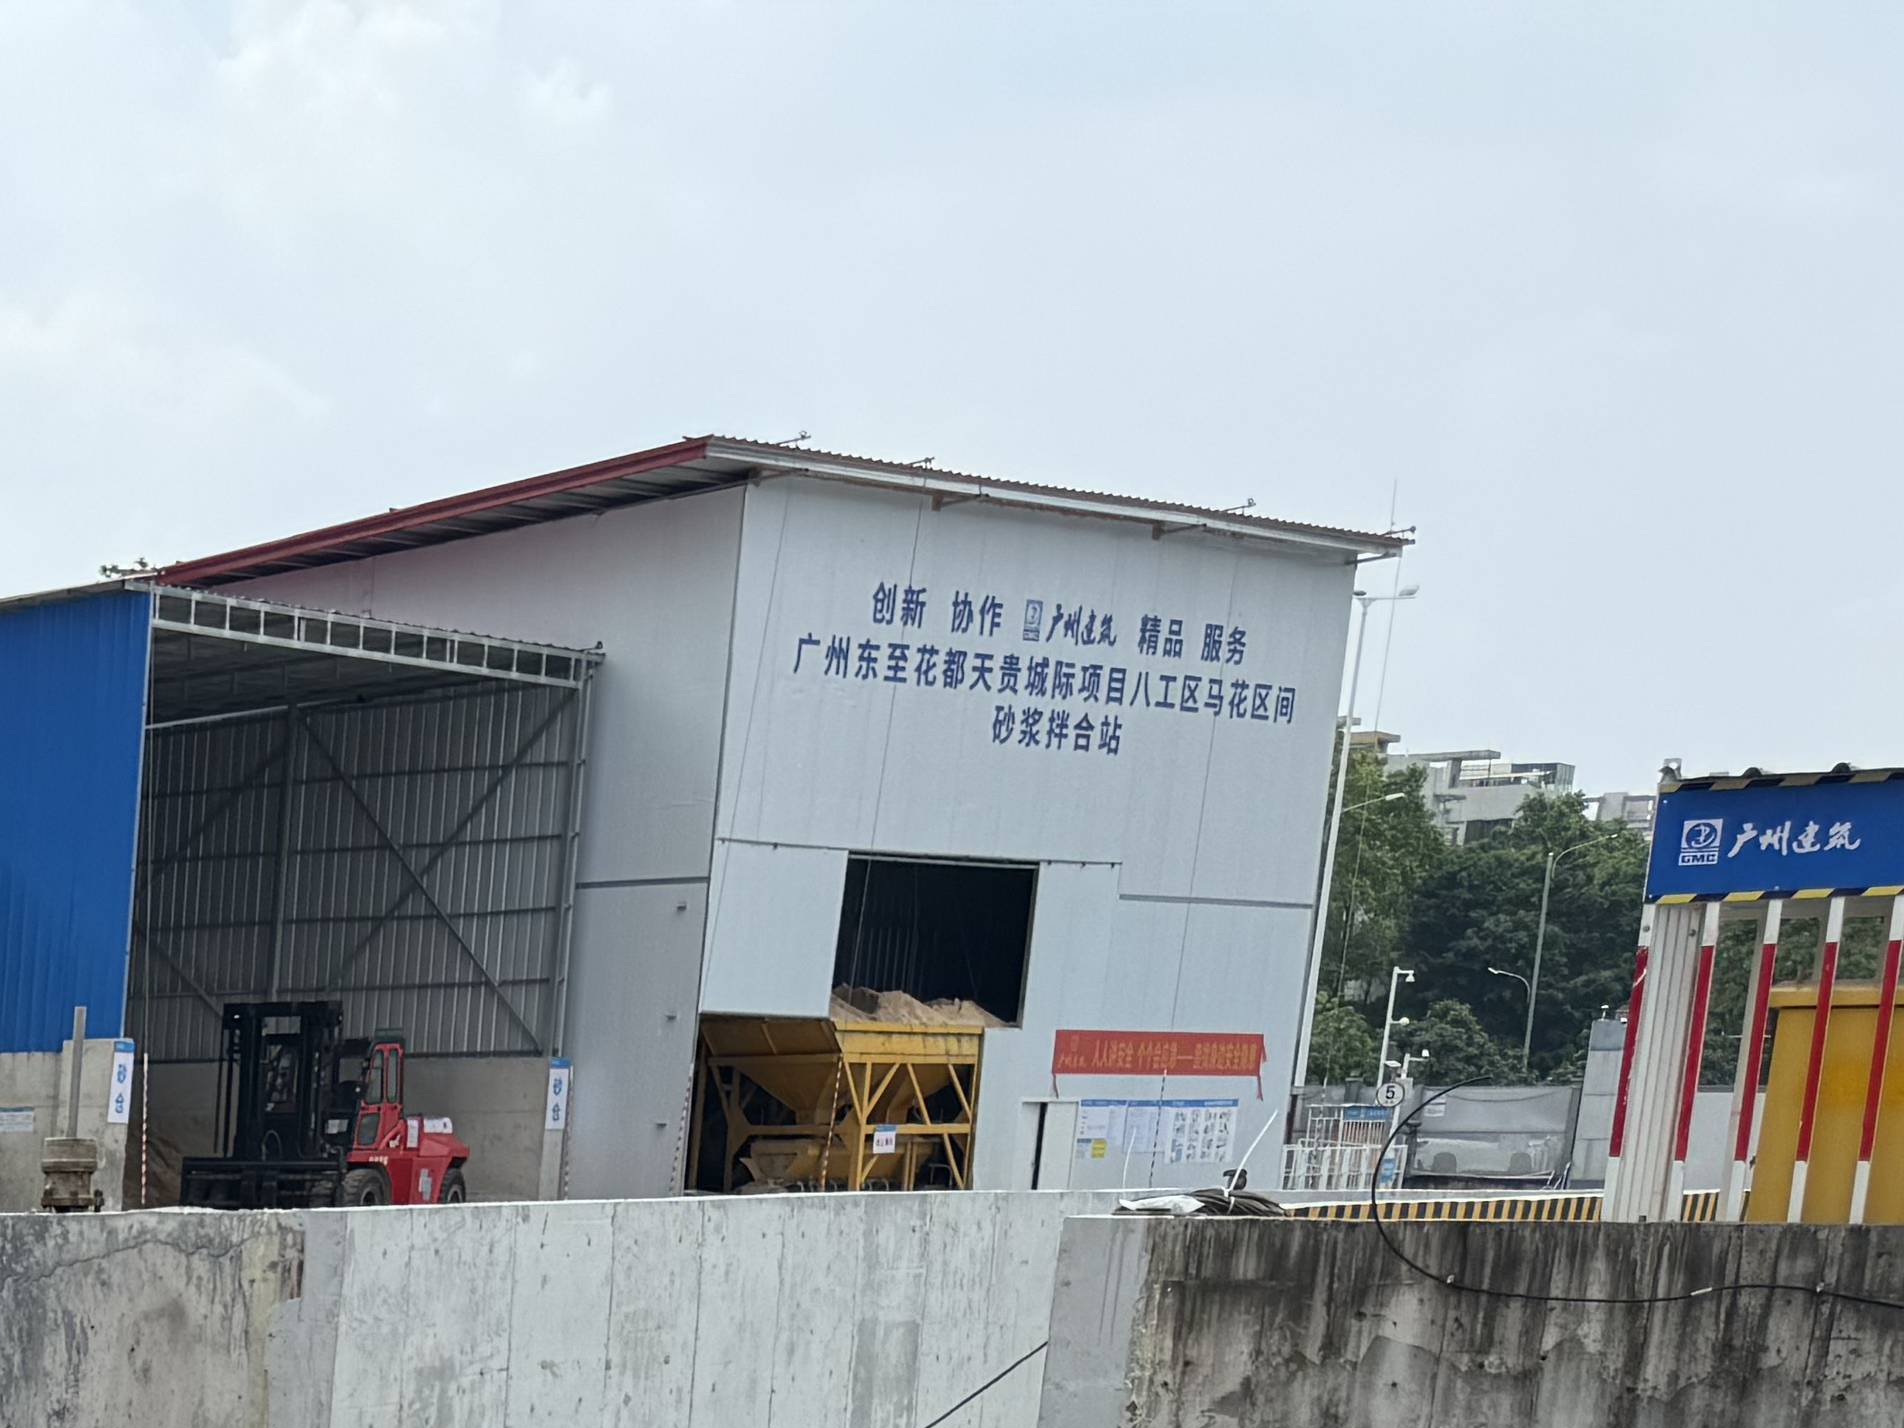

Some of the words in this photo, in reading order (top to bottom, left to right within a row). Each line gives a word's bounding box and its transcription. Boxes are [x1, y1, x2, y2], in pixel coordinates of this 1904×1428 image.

[872, 581, 927, 629] 创新
[951, 590, 1003, 637] 协作
[1045, 603, 1117, 648] 广州建筑
[1138, 613, 1183, 659] 精品
[1200, 623, 1247, 666] 服务
[792, 632, 1296, 725] 广州东至花都天贵城际项目八工区马花区间
[991, 704, 1123, 755] 砂浆拌合站
[1680, 853, 1718, 865] GMC
[1727, 820, 1862, 859] 广州建筑
